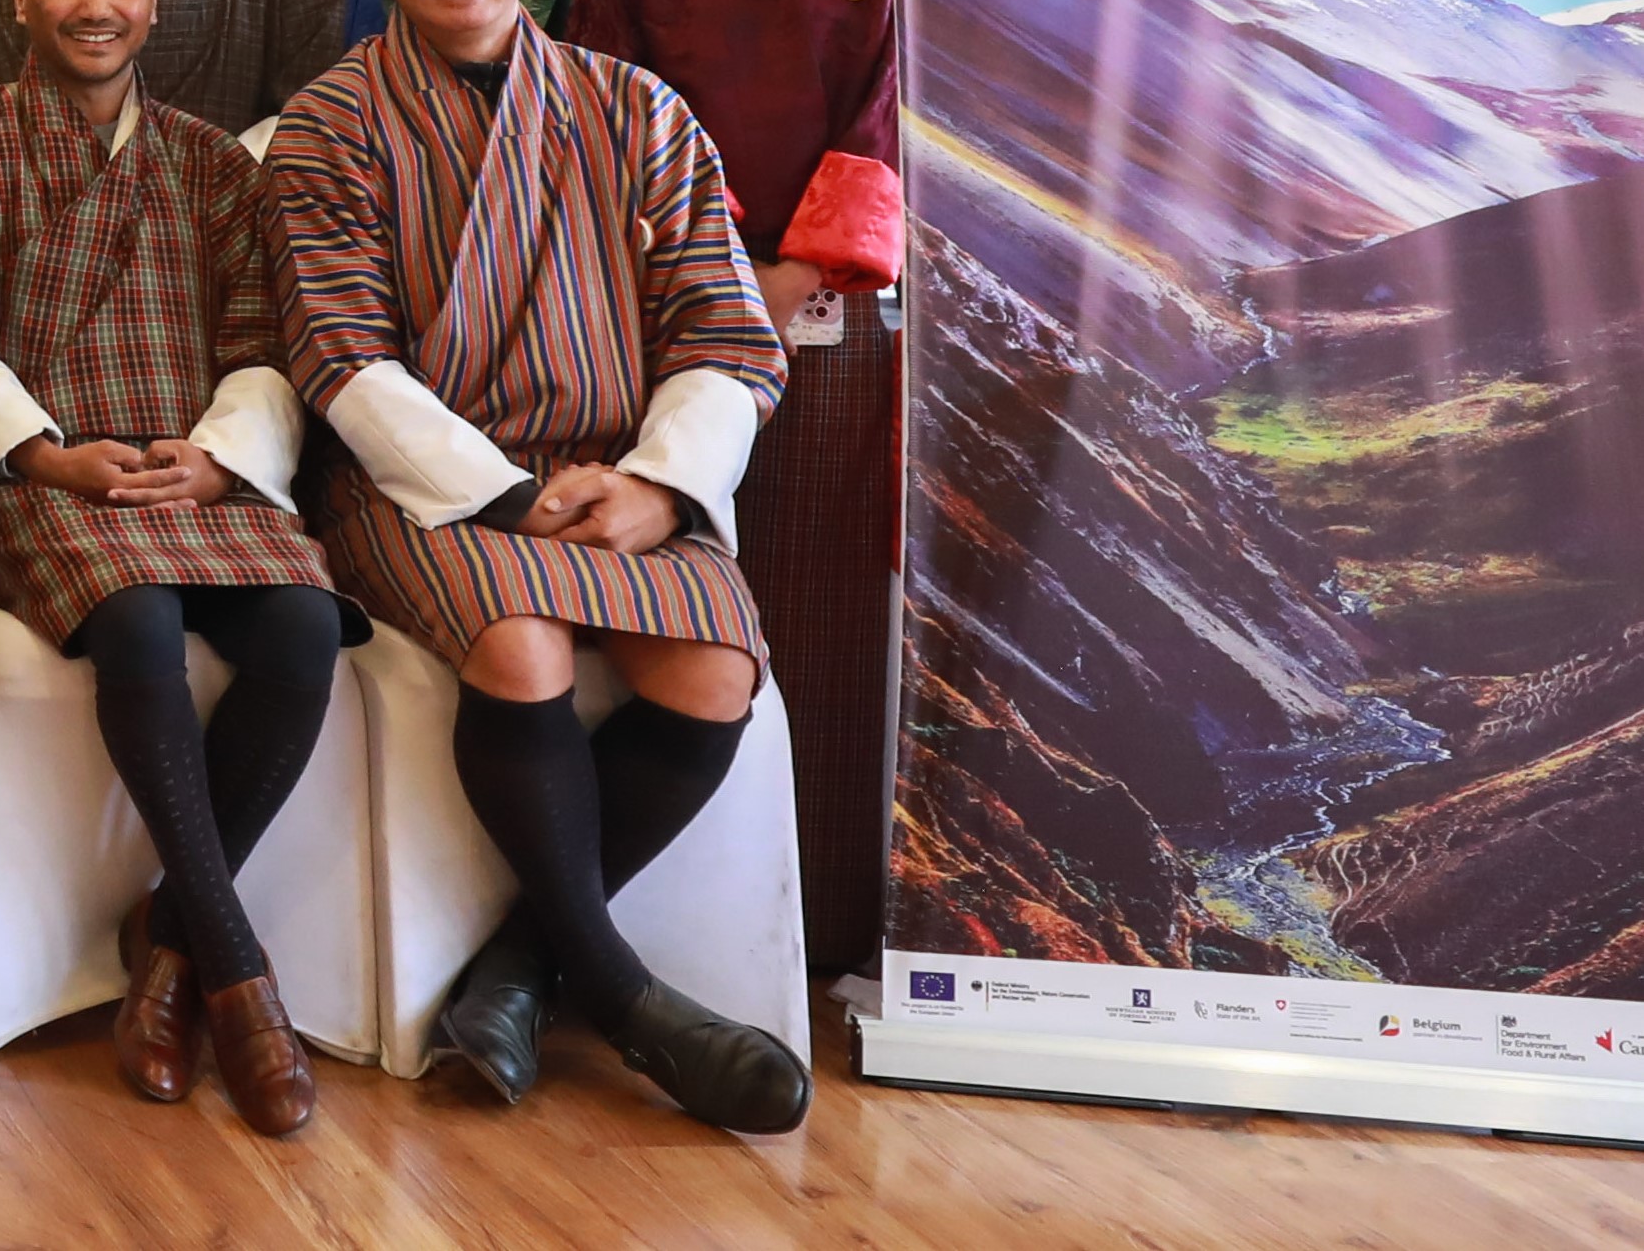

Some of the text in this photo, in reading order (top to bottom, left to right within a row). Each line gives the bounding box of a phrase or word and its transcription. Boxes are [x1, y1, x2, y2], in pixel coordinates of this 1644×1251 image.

[1216, 1003, 1256, 1014] Flanders
[1413, 1018, 1462, 1032] Belgium
[1501, 1029, 1551, 1041] Department
[1501, 1039, 1568, 1051] for Environment
[1501, 1048, 1586, 1062] Food & Rural Affairs
